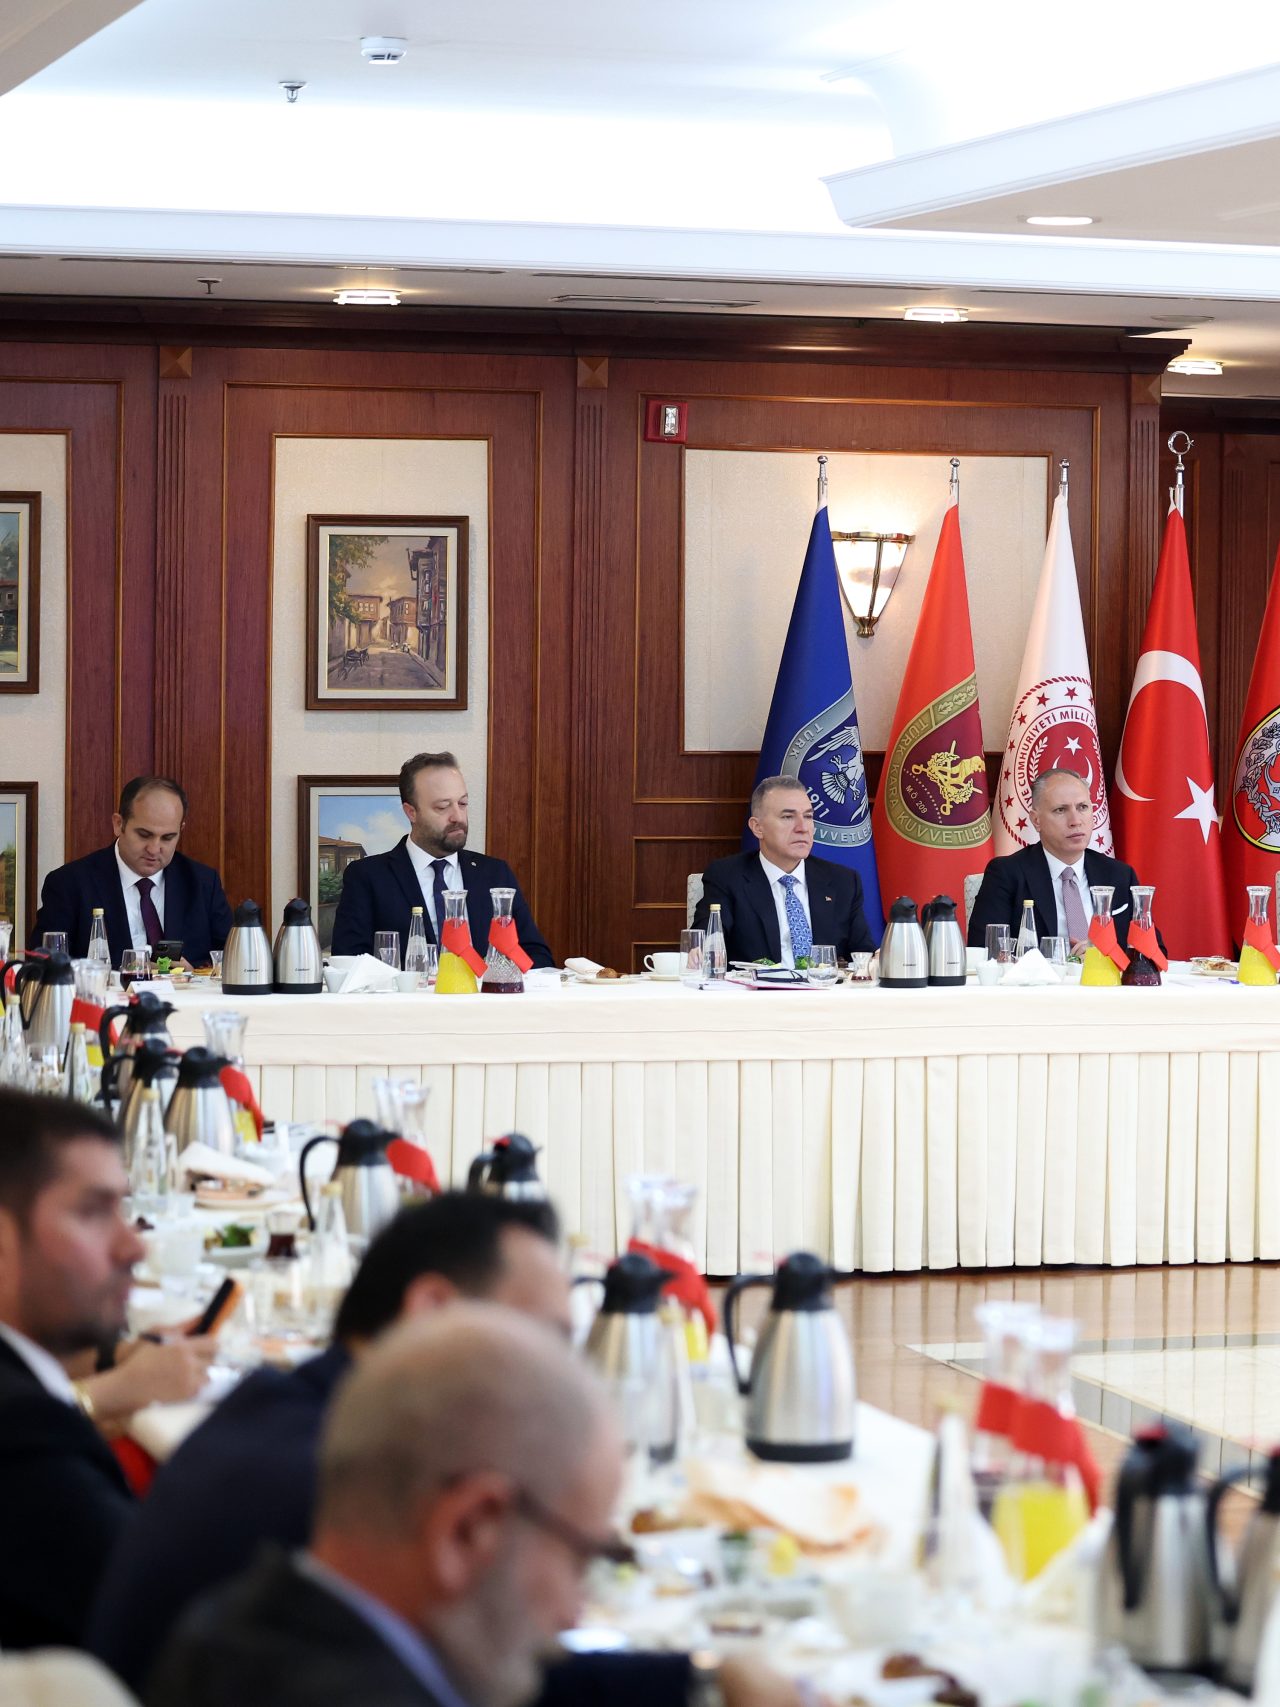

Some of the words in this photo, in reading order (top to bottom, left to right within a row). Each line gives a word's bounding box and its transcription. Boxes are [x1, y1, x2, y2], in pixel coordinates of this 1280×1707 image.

[789, 723, 823, 760] TÜRK
[897, 718, 929, 757] TÜRK
[1018, 712, 1057, 787] CUMHURİYETİ
[1060, 709, 1089, 723] MİLLİ
[806, 786, 830, 818] 1911
[888, 763, 899, 809] KARA
